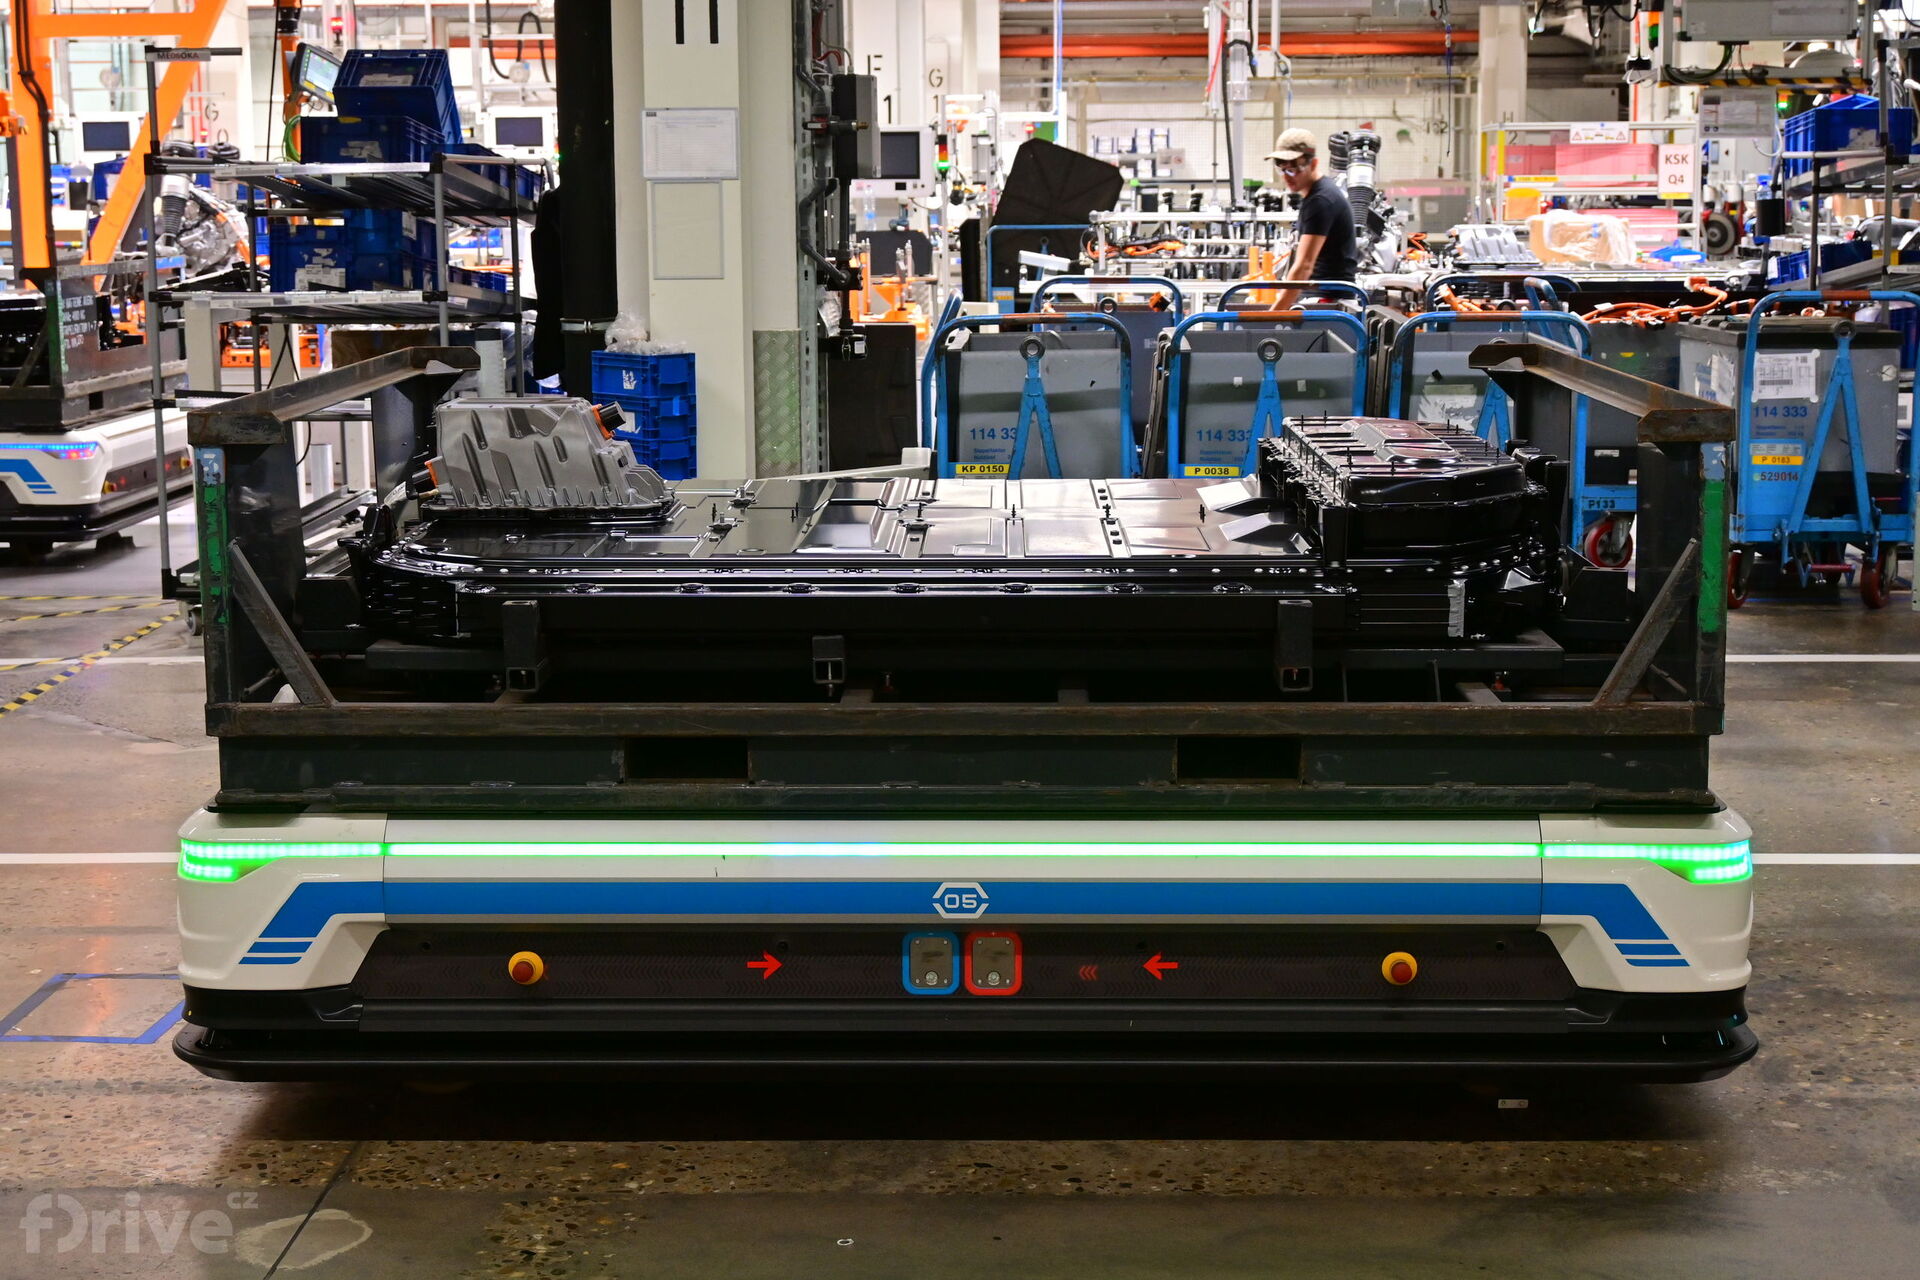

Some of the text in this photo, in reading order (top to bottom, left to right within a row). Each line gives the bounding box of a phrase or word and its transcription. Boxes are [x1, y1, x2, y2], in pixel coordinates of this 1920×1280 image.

[928, 68, 943, 88] G
[205, 102, 219, 122] G
[884, 94, 892, 124] 1
[1665, 153, 1688, 164] KSK
[1668, 174, 1684, 186] Q4
[1754, 406, 1808, 418] 114 333
[970, 428, 996, 440] 114
[1196, 430, 1223, 442] 114
[1204, 468, 1230, 476] 0038
[944, 894, 978, 908] 05
